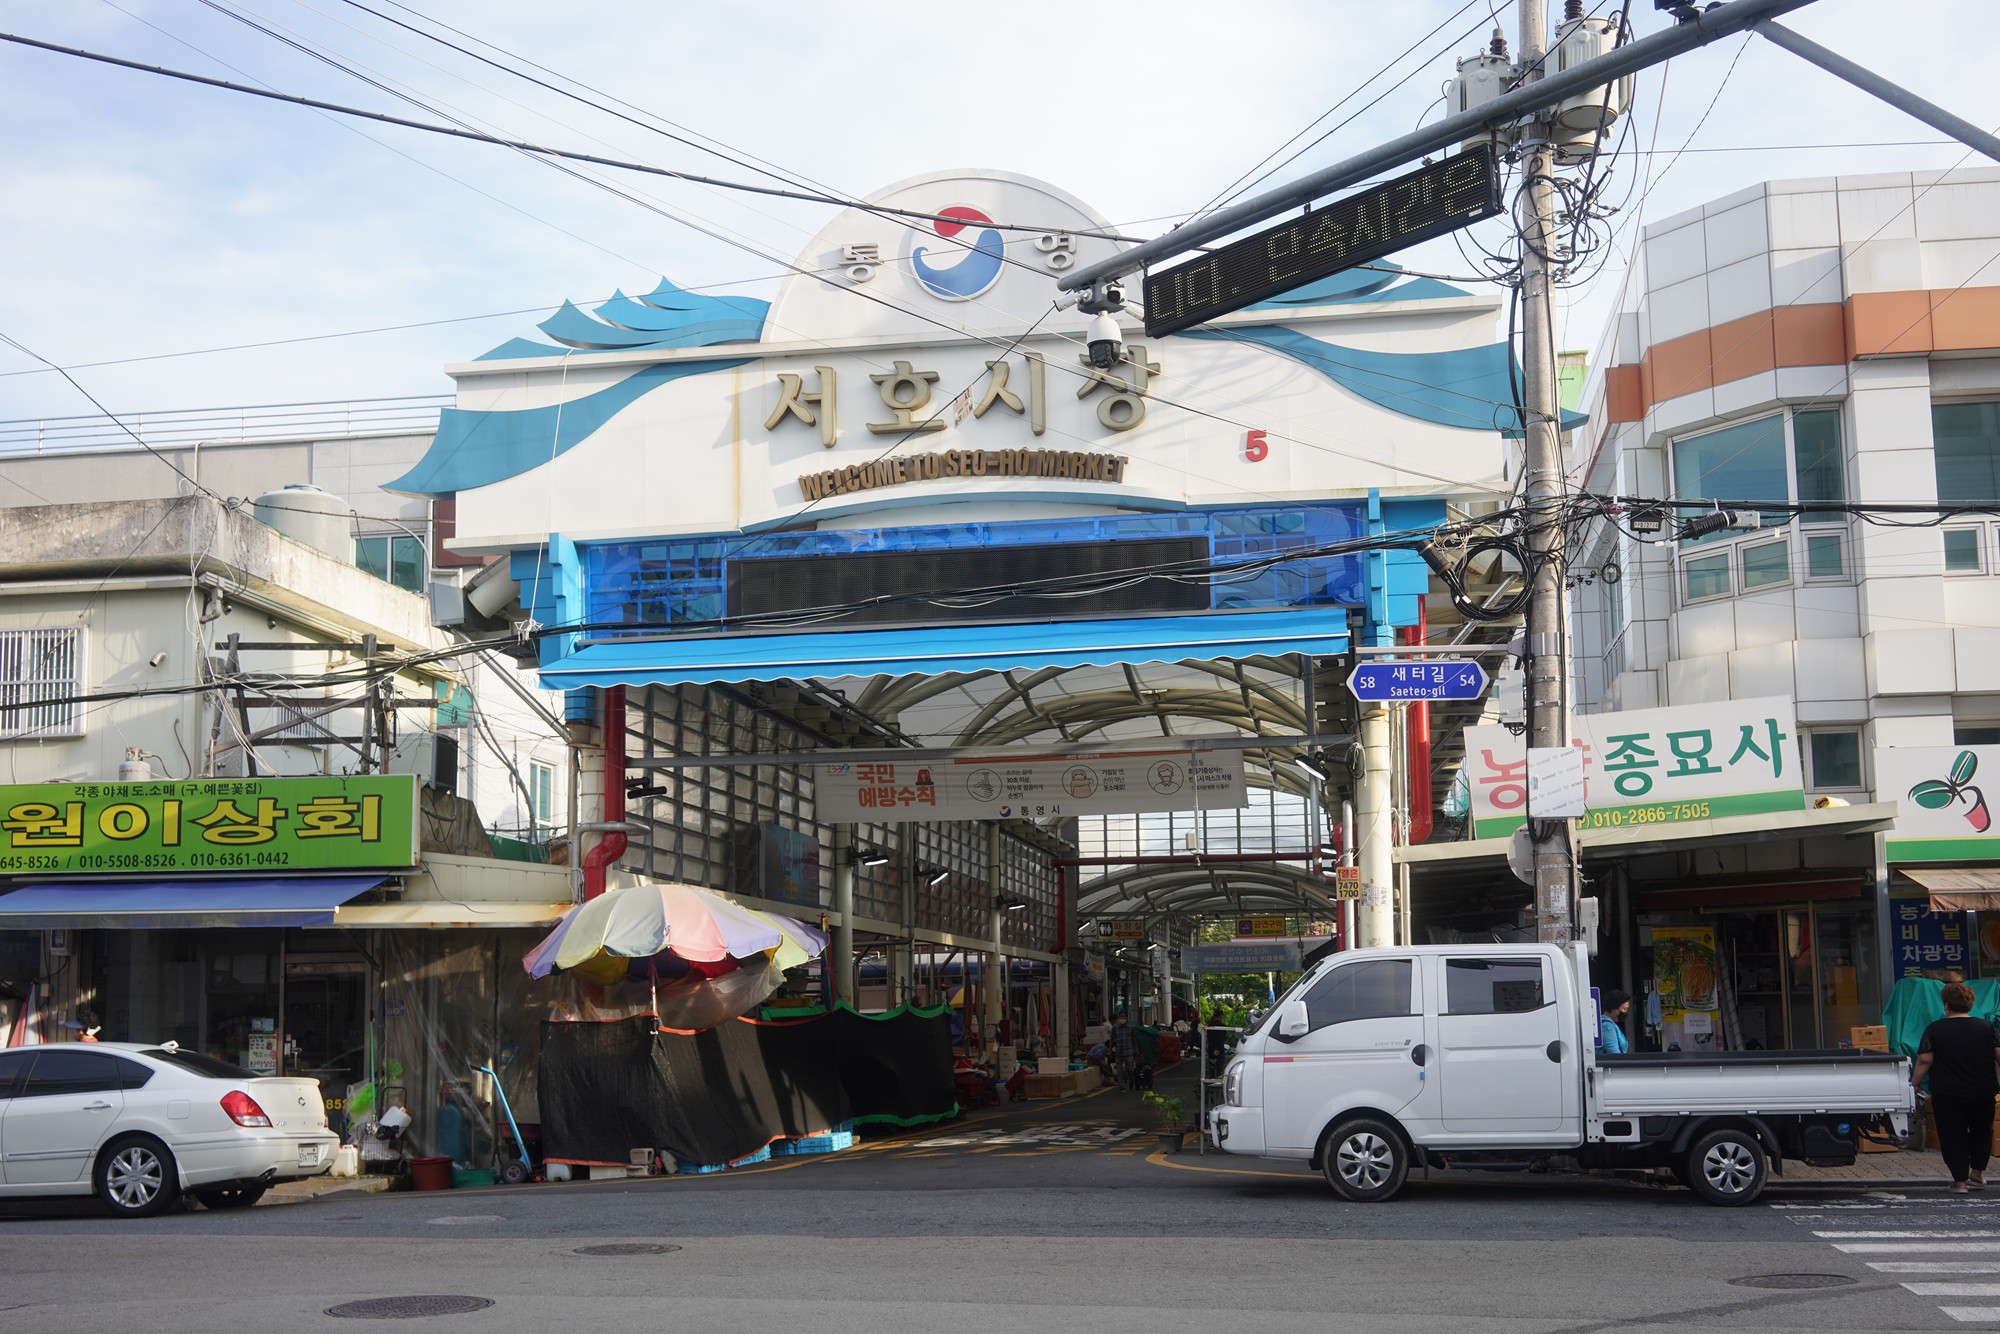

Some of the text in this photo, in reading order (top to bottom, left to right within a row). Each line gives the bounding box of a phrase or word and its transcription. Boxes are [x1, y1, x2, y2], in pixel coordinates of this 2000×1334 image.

[1151, 158, 1486, 319] 니다. 단속시간은
[763, 344, 1162, 449] 서호시장
[1245, 430, 1269, 462] 5
[797, 448, 1129, 502] WELCOME TO SEO-HO MARKET
[1359, 676, 1376, 689] 58
[1391, 666, 1445, 683] 새터길
[1459, 674, 1476, 687] 54
[1390, 686, 1446, 698] Saeteo-gil
[856, 763, 896, 785] 국민
[858, 785, 937, 808] 예방수칙
[1, 793, 383, 848] 원이상회
[1593, 802, 1711, 828] 010-2866-7505
[79, 853, 176, 868] 010-5508-8526
[190, 852, 289, 867] 010-6361-0442
[1338, 881, 1359, 890] 7470
[1338, 889, 1359, 898] 1700
[1254, 919, 1283, 929] 금연구역
[1902, 944, 1964, 962] 차광망
